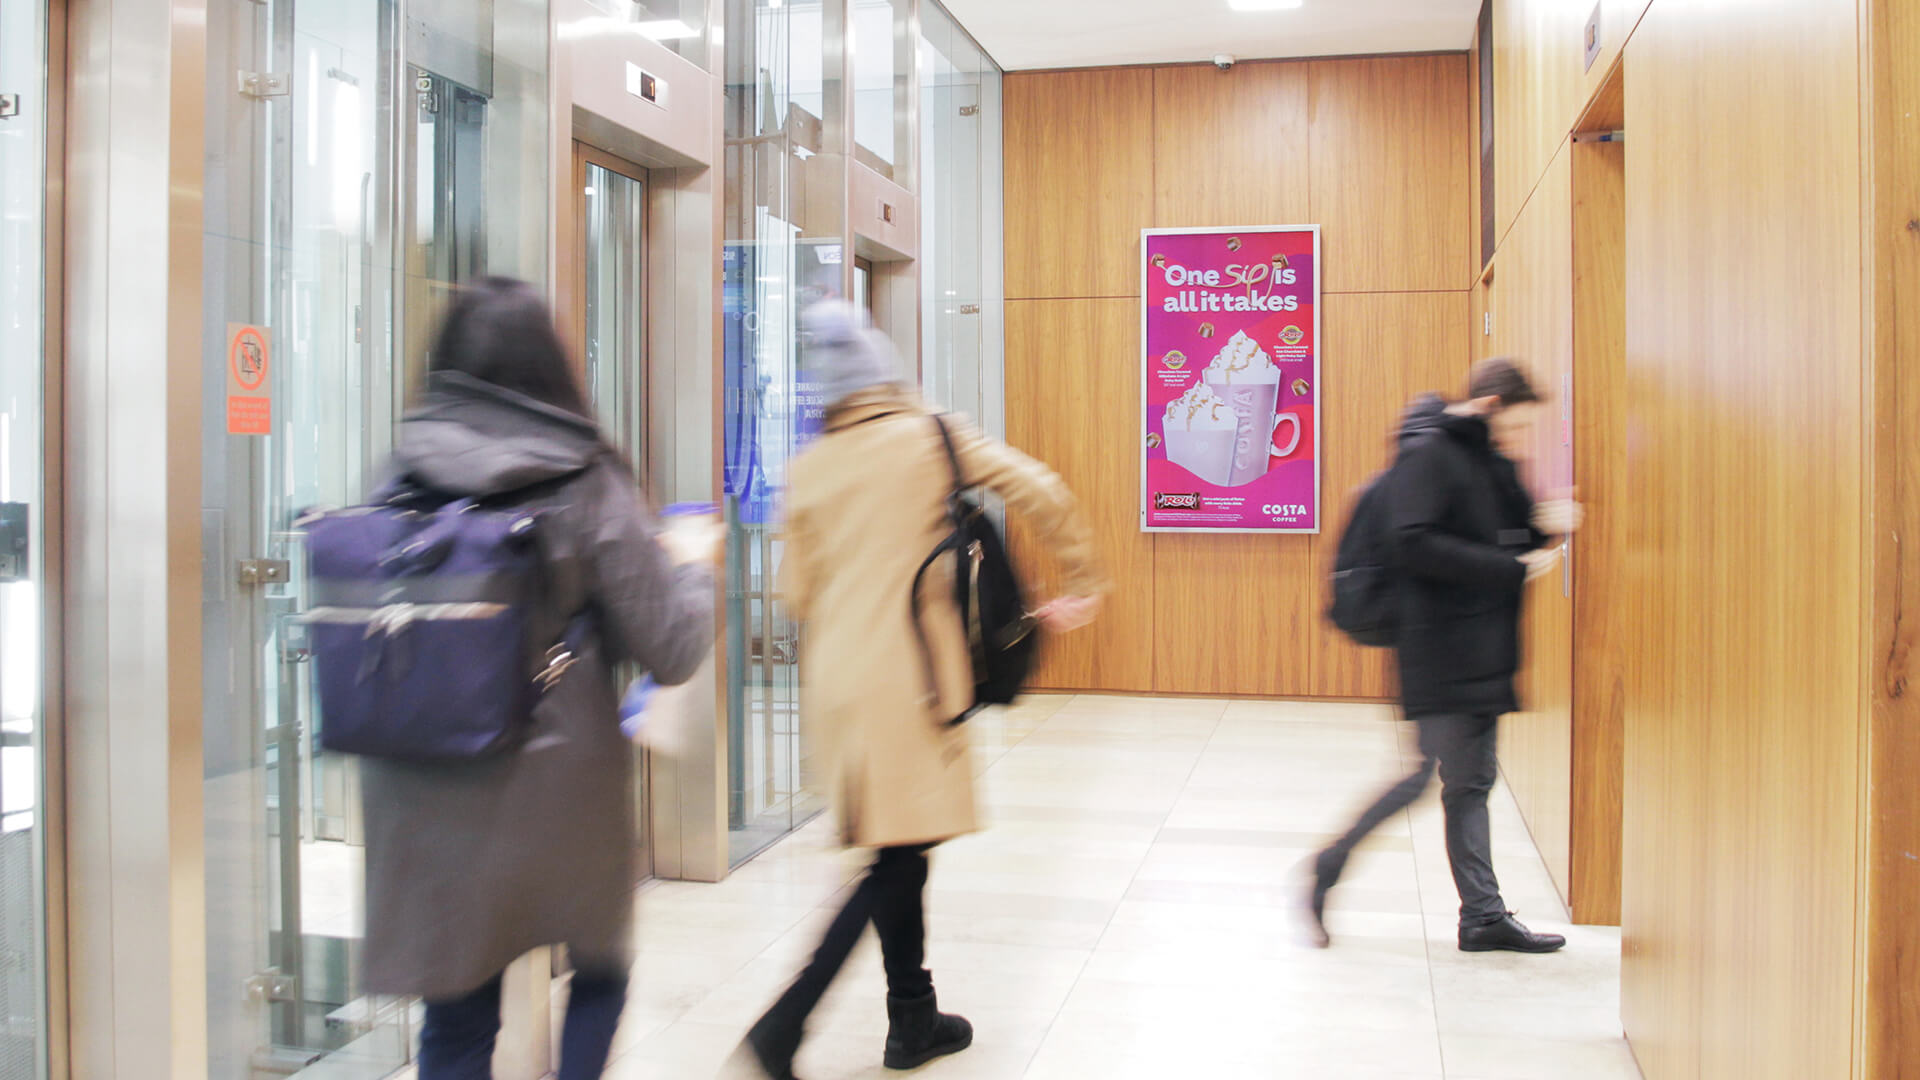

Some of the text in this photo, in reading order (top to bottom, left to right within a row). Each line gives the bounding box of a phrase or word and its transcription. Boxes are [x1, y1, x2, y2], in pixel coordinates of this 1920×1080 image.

[1165, 264, 1220, 287] One
[1275, 266, 1297, 285] is
[1163, 290, 1299, 312] all it takes
[1262, 504, 1307, 516] COSTA
